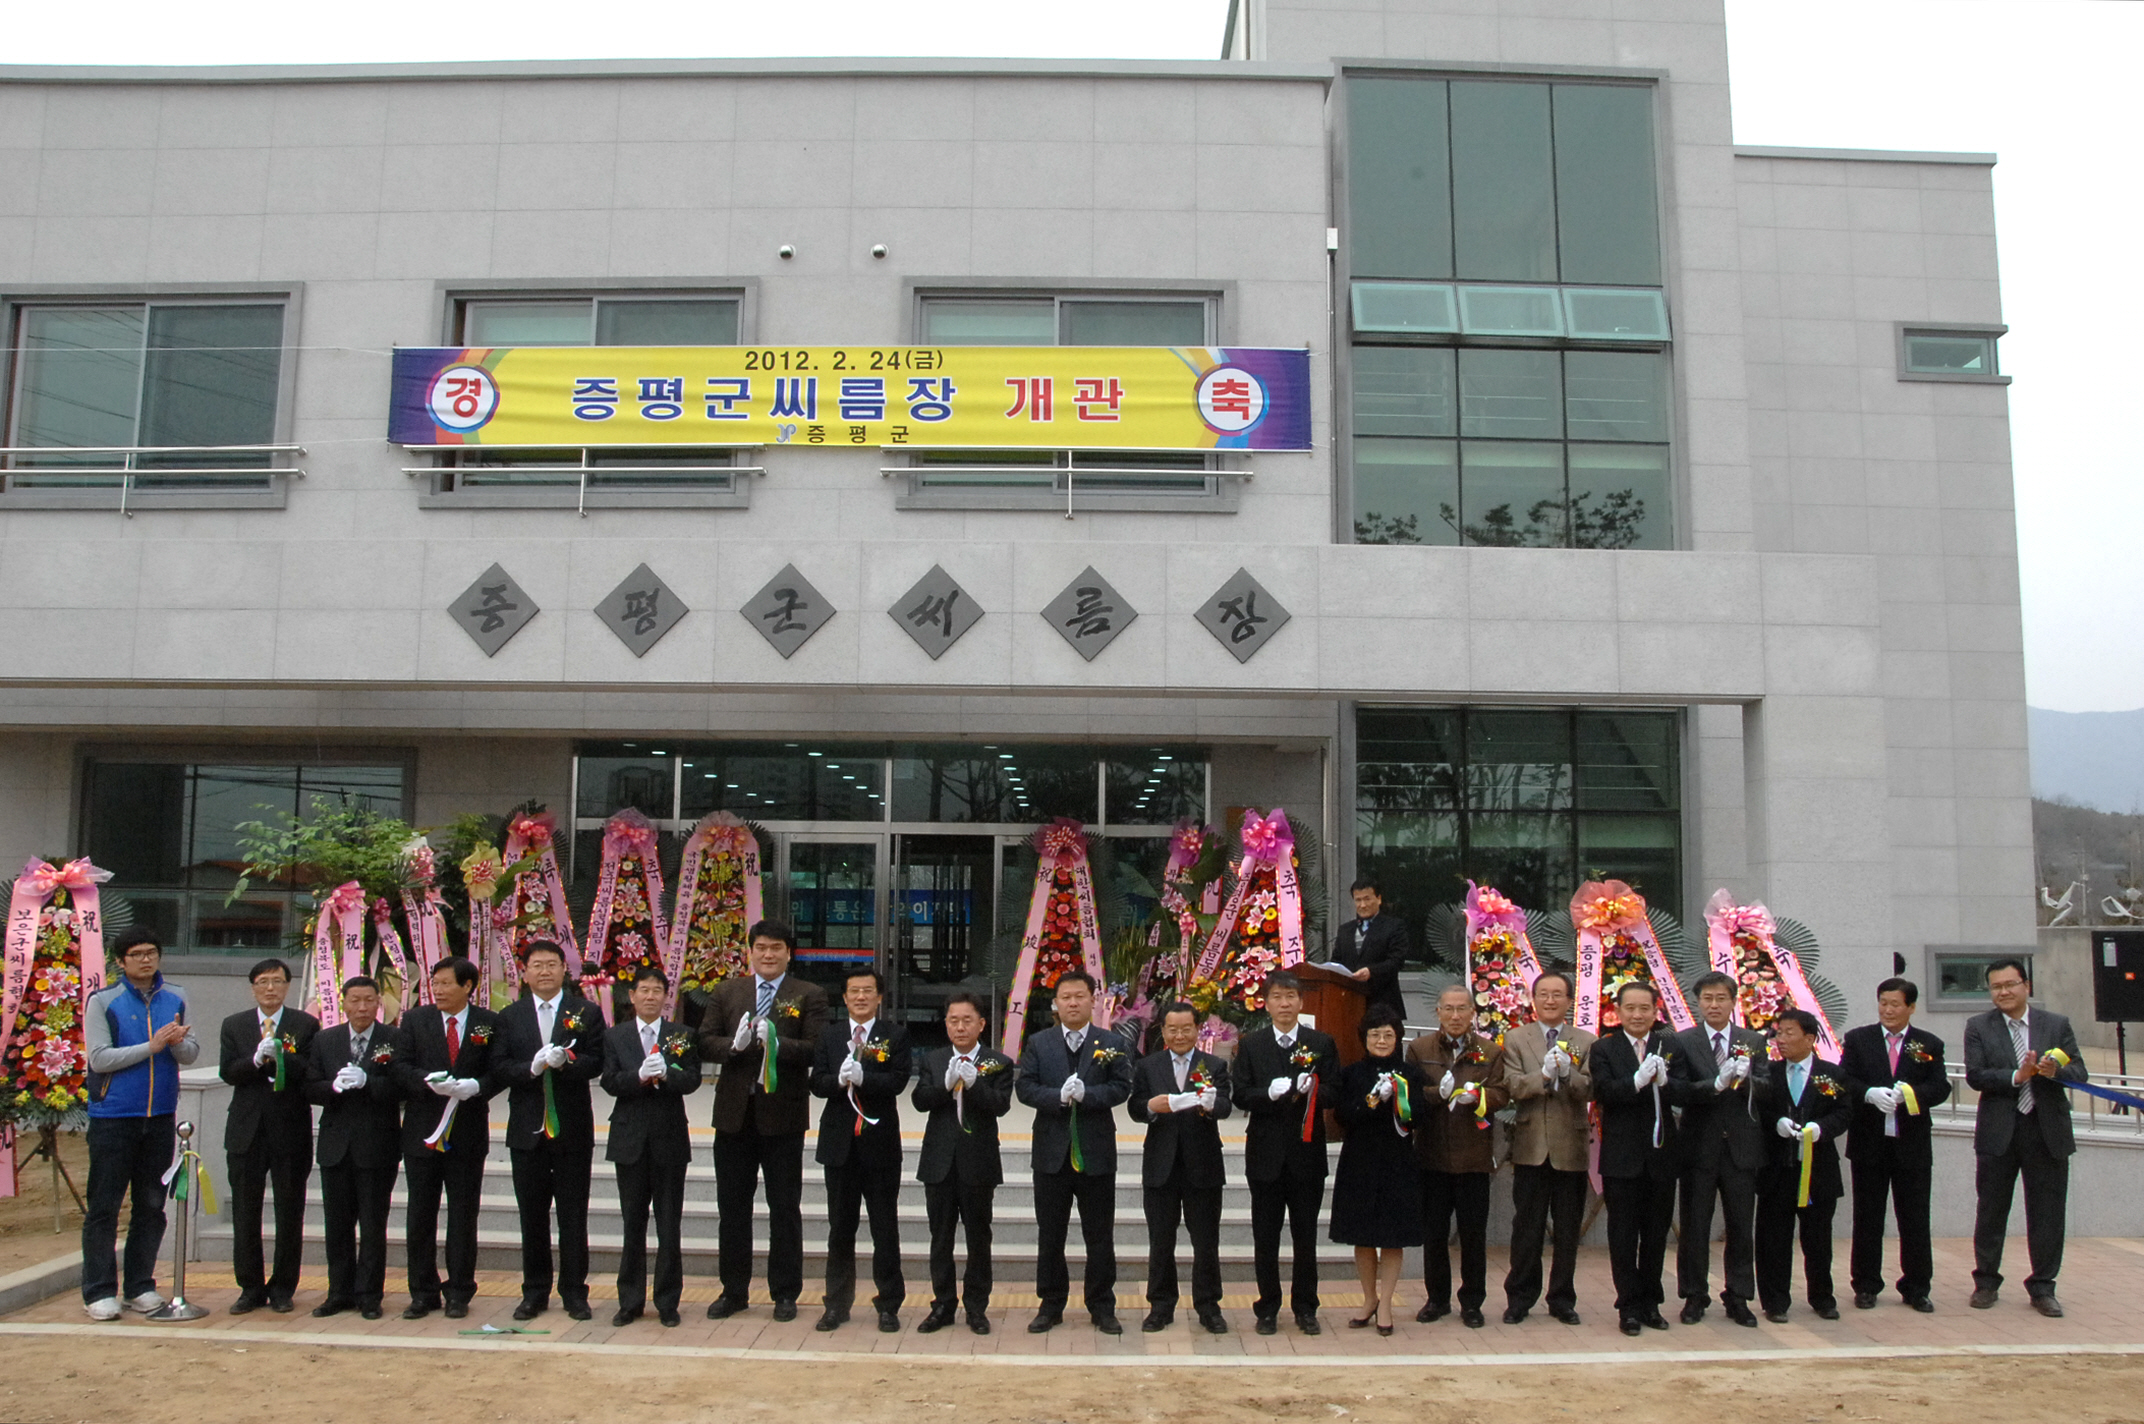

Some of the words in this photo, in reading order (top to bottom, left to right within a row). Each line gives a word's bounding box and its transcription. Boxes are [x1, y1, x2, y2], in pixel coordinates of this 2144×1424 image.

[745, 350, 819, 371] 2012.
[832, 350, 856, 371] 2.
[870, 350, 944, 371] 24(금)
[446, 377, 483, 418] 경
[572, 377, 956, 422] 증평군씨름장
[1005, 377, 1125, 422] 개관
[1211, 378, 1253, 421] 축
[744, 851, 759, 877] 祝
[1038, 866, 1053, 883] 祝
[1280, 870, 1297, 900] 축
[82, 910, 99, 933] 祝
[345, 933, 360, 950] 祝
[1580, 944, 1597, 978] 증평
